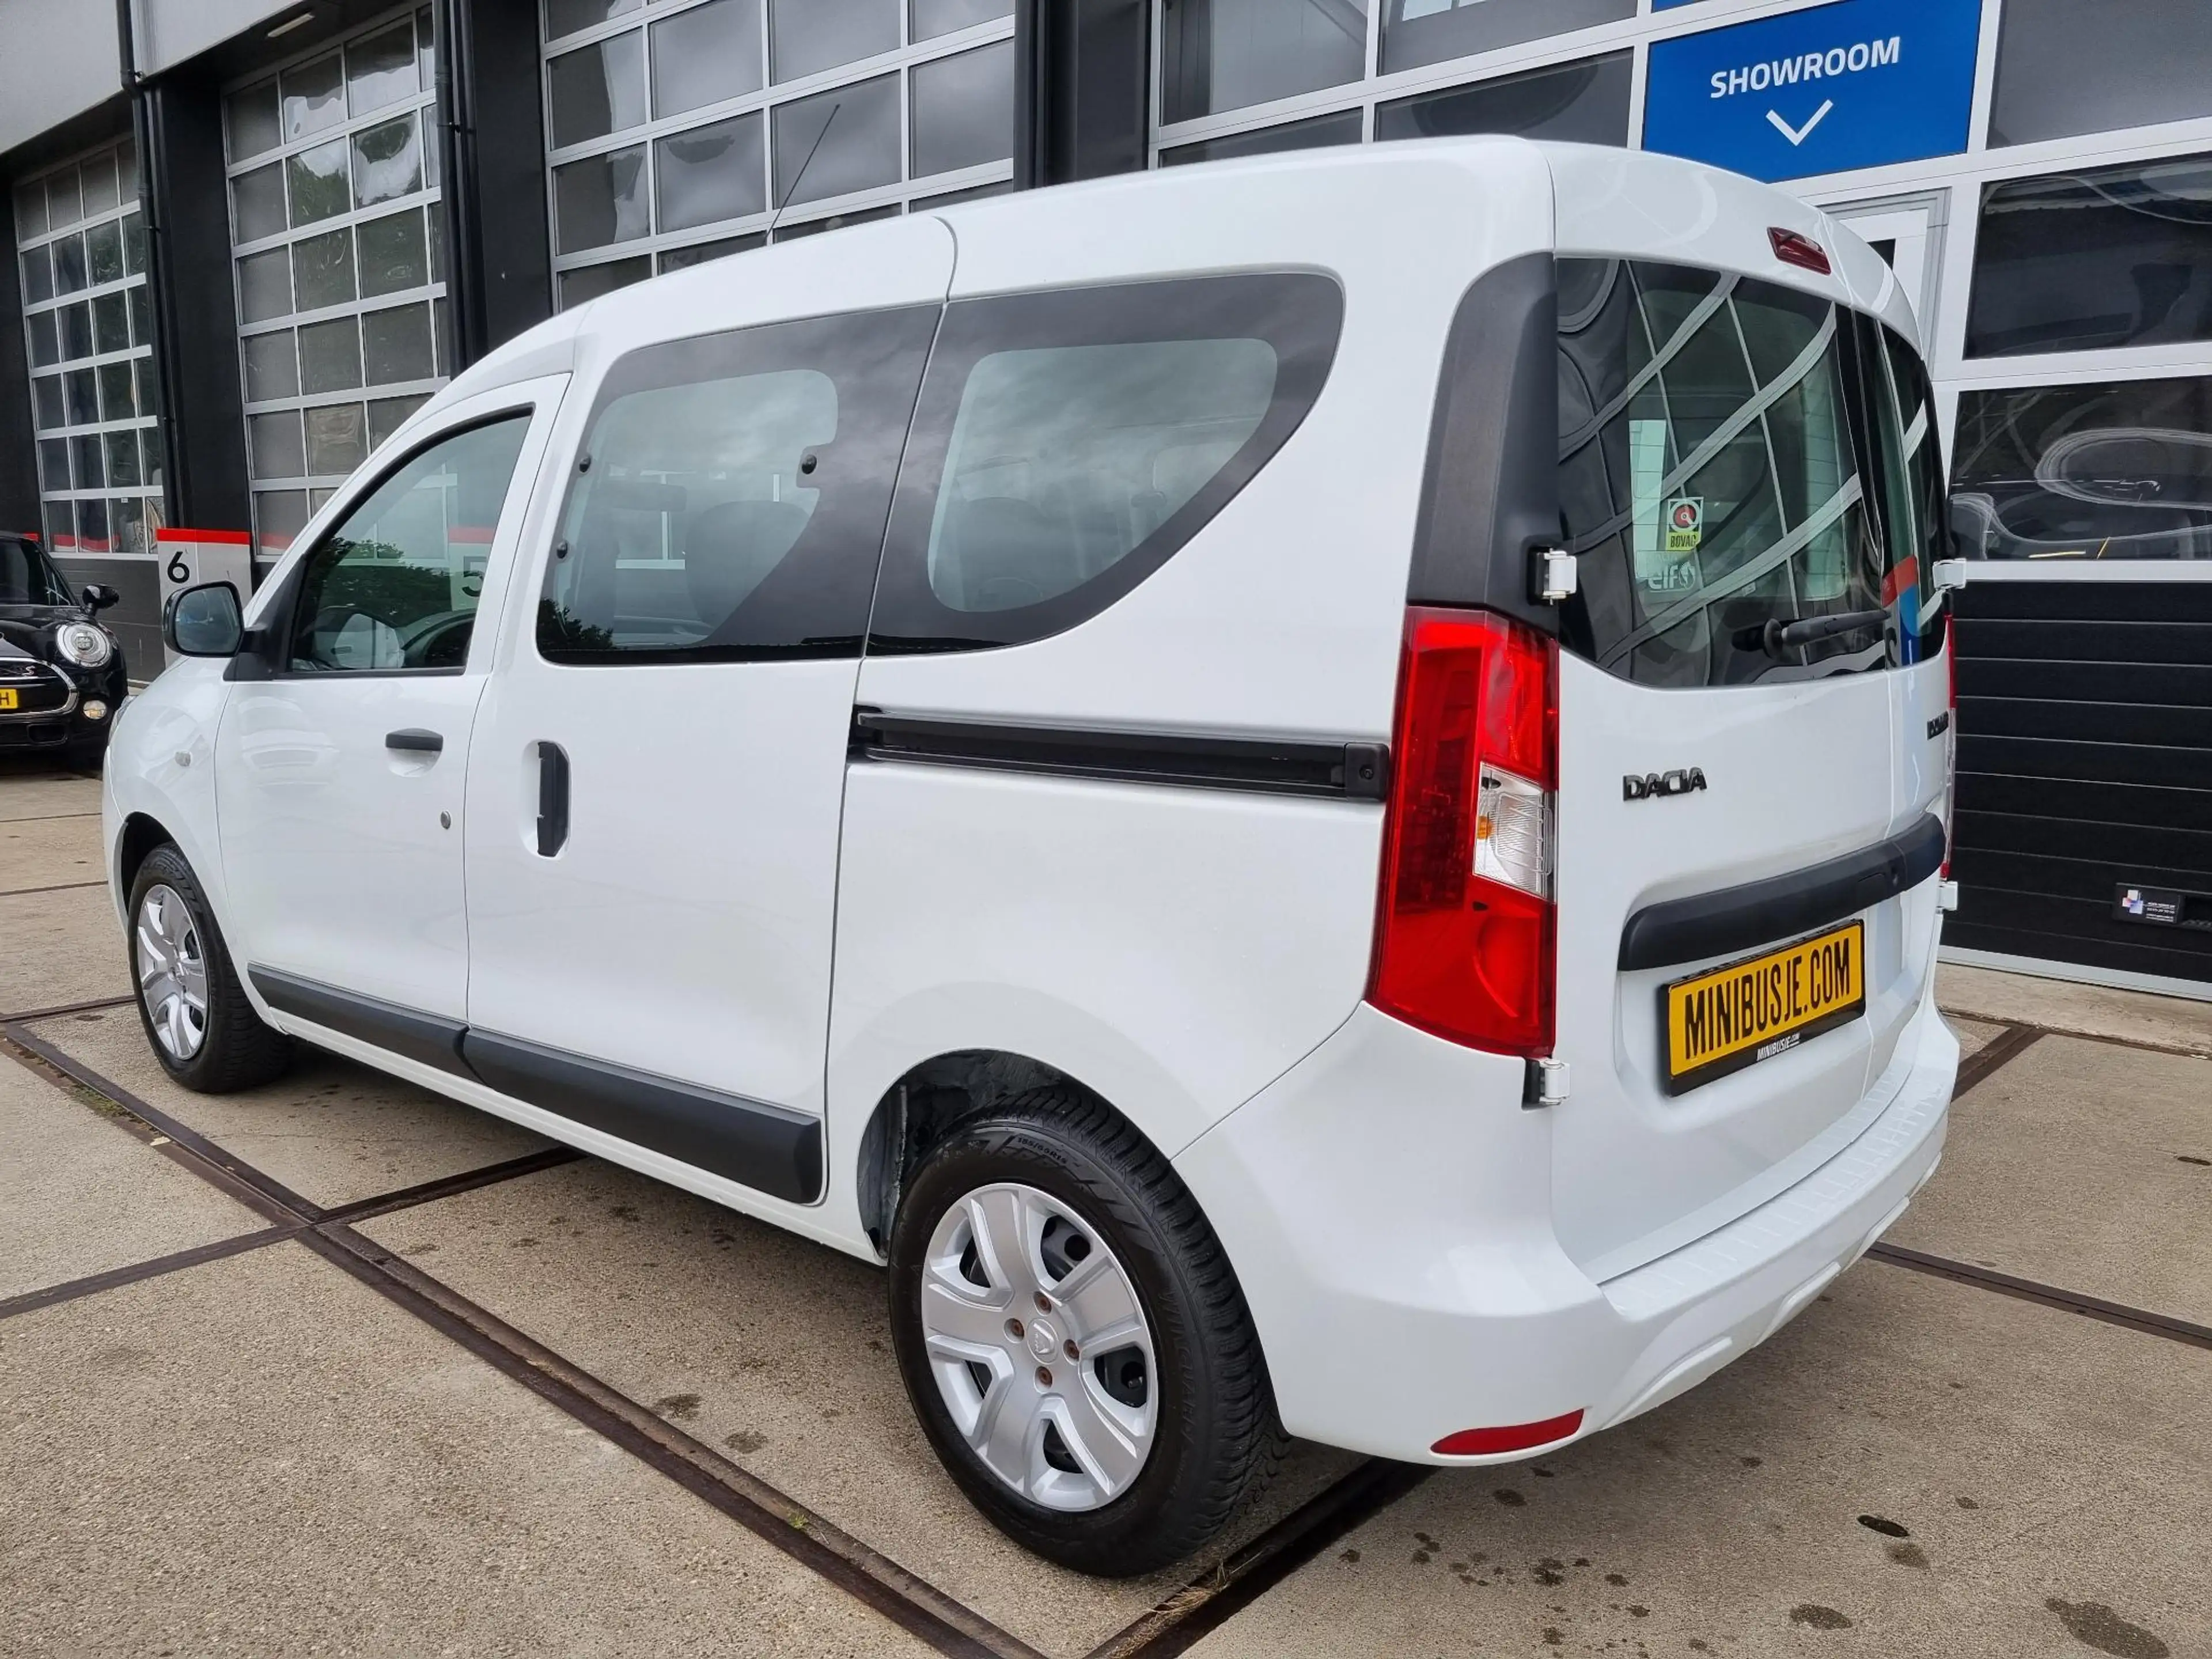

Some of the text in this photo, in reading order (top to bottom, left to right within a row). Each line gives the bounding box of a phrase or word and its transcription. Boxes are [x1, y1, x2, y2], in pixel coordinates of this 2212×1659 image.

[1710, 36, 1900, 98] SHOWROOM
[1671, 535, 1696, 548] BOVAG
[168, 551, 190, 584] 6
[462, 556, 487, 597] 5
[1623, 767, 1707, 801] DACIA
[1685, 937, 1850, 1060] MINIBUSJE.COM
